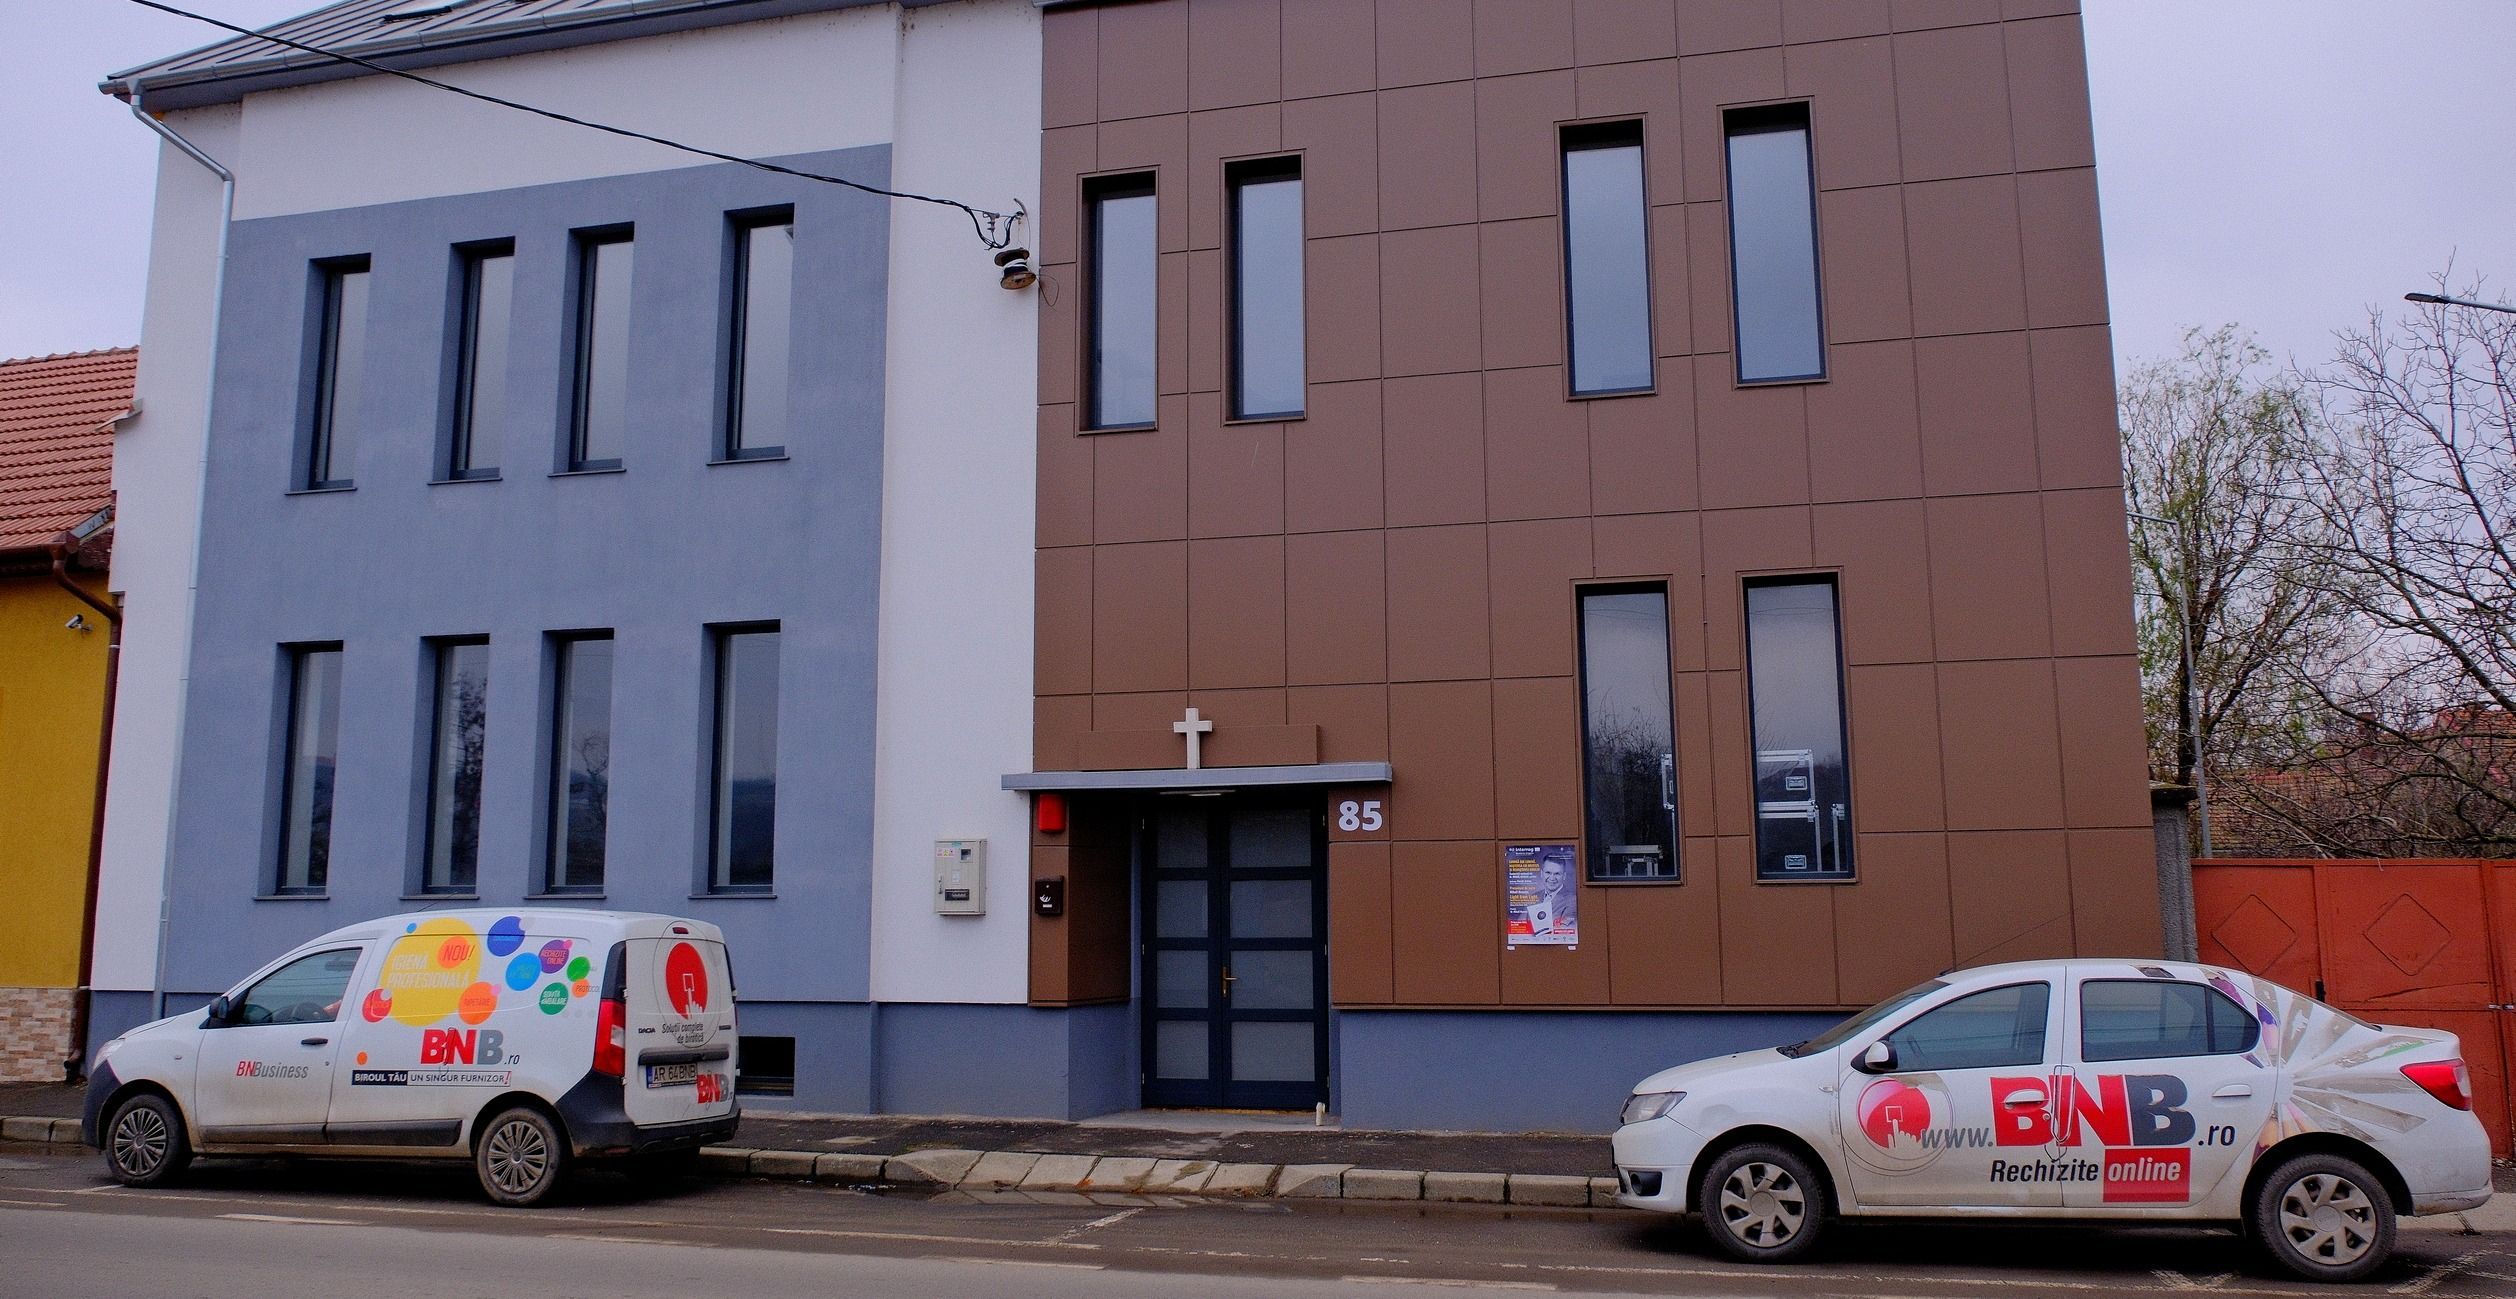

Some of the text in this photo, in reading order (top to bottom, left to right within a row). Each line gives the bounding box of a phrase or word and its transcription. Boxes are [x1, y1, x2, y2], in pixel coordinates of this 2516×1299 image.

[1339, 801, 1382, 831] 85
[443, 945, 475, 961] NOU!
[677, 1033, 684, 1044] de
[236, 1060, 309, 1079] BNBusiness
[354, 1074, 387, 1082] BIROUL
[410, 1074, 423, 1082] UN
[426, 1074, 458, 1082] SINGUR
[1990, 1157, 2182, 1183] Rechizite online
